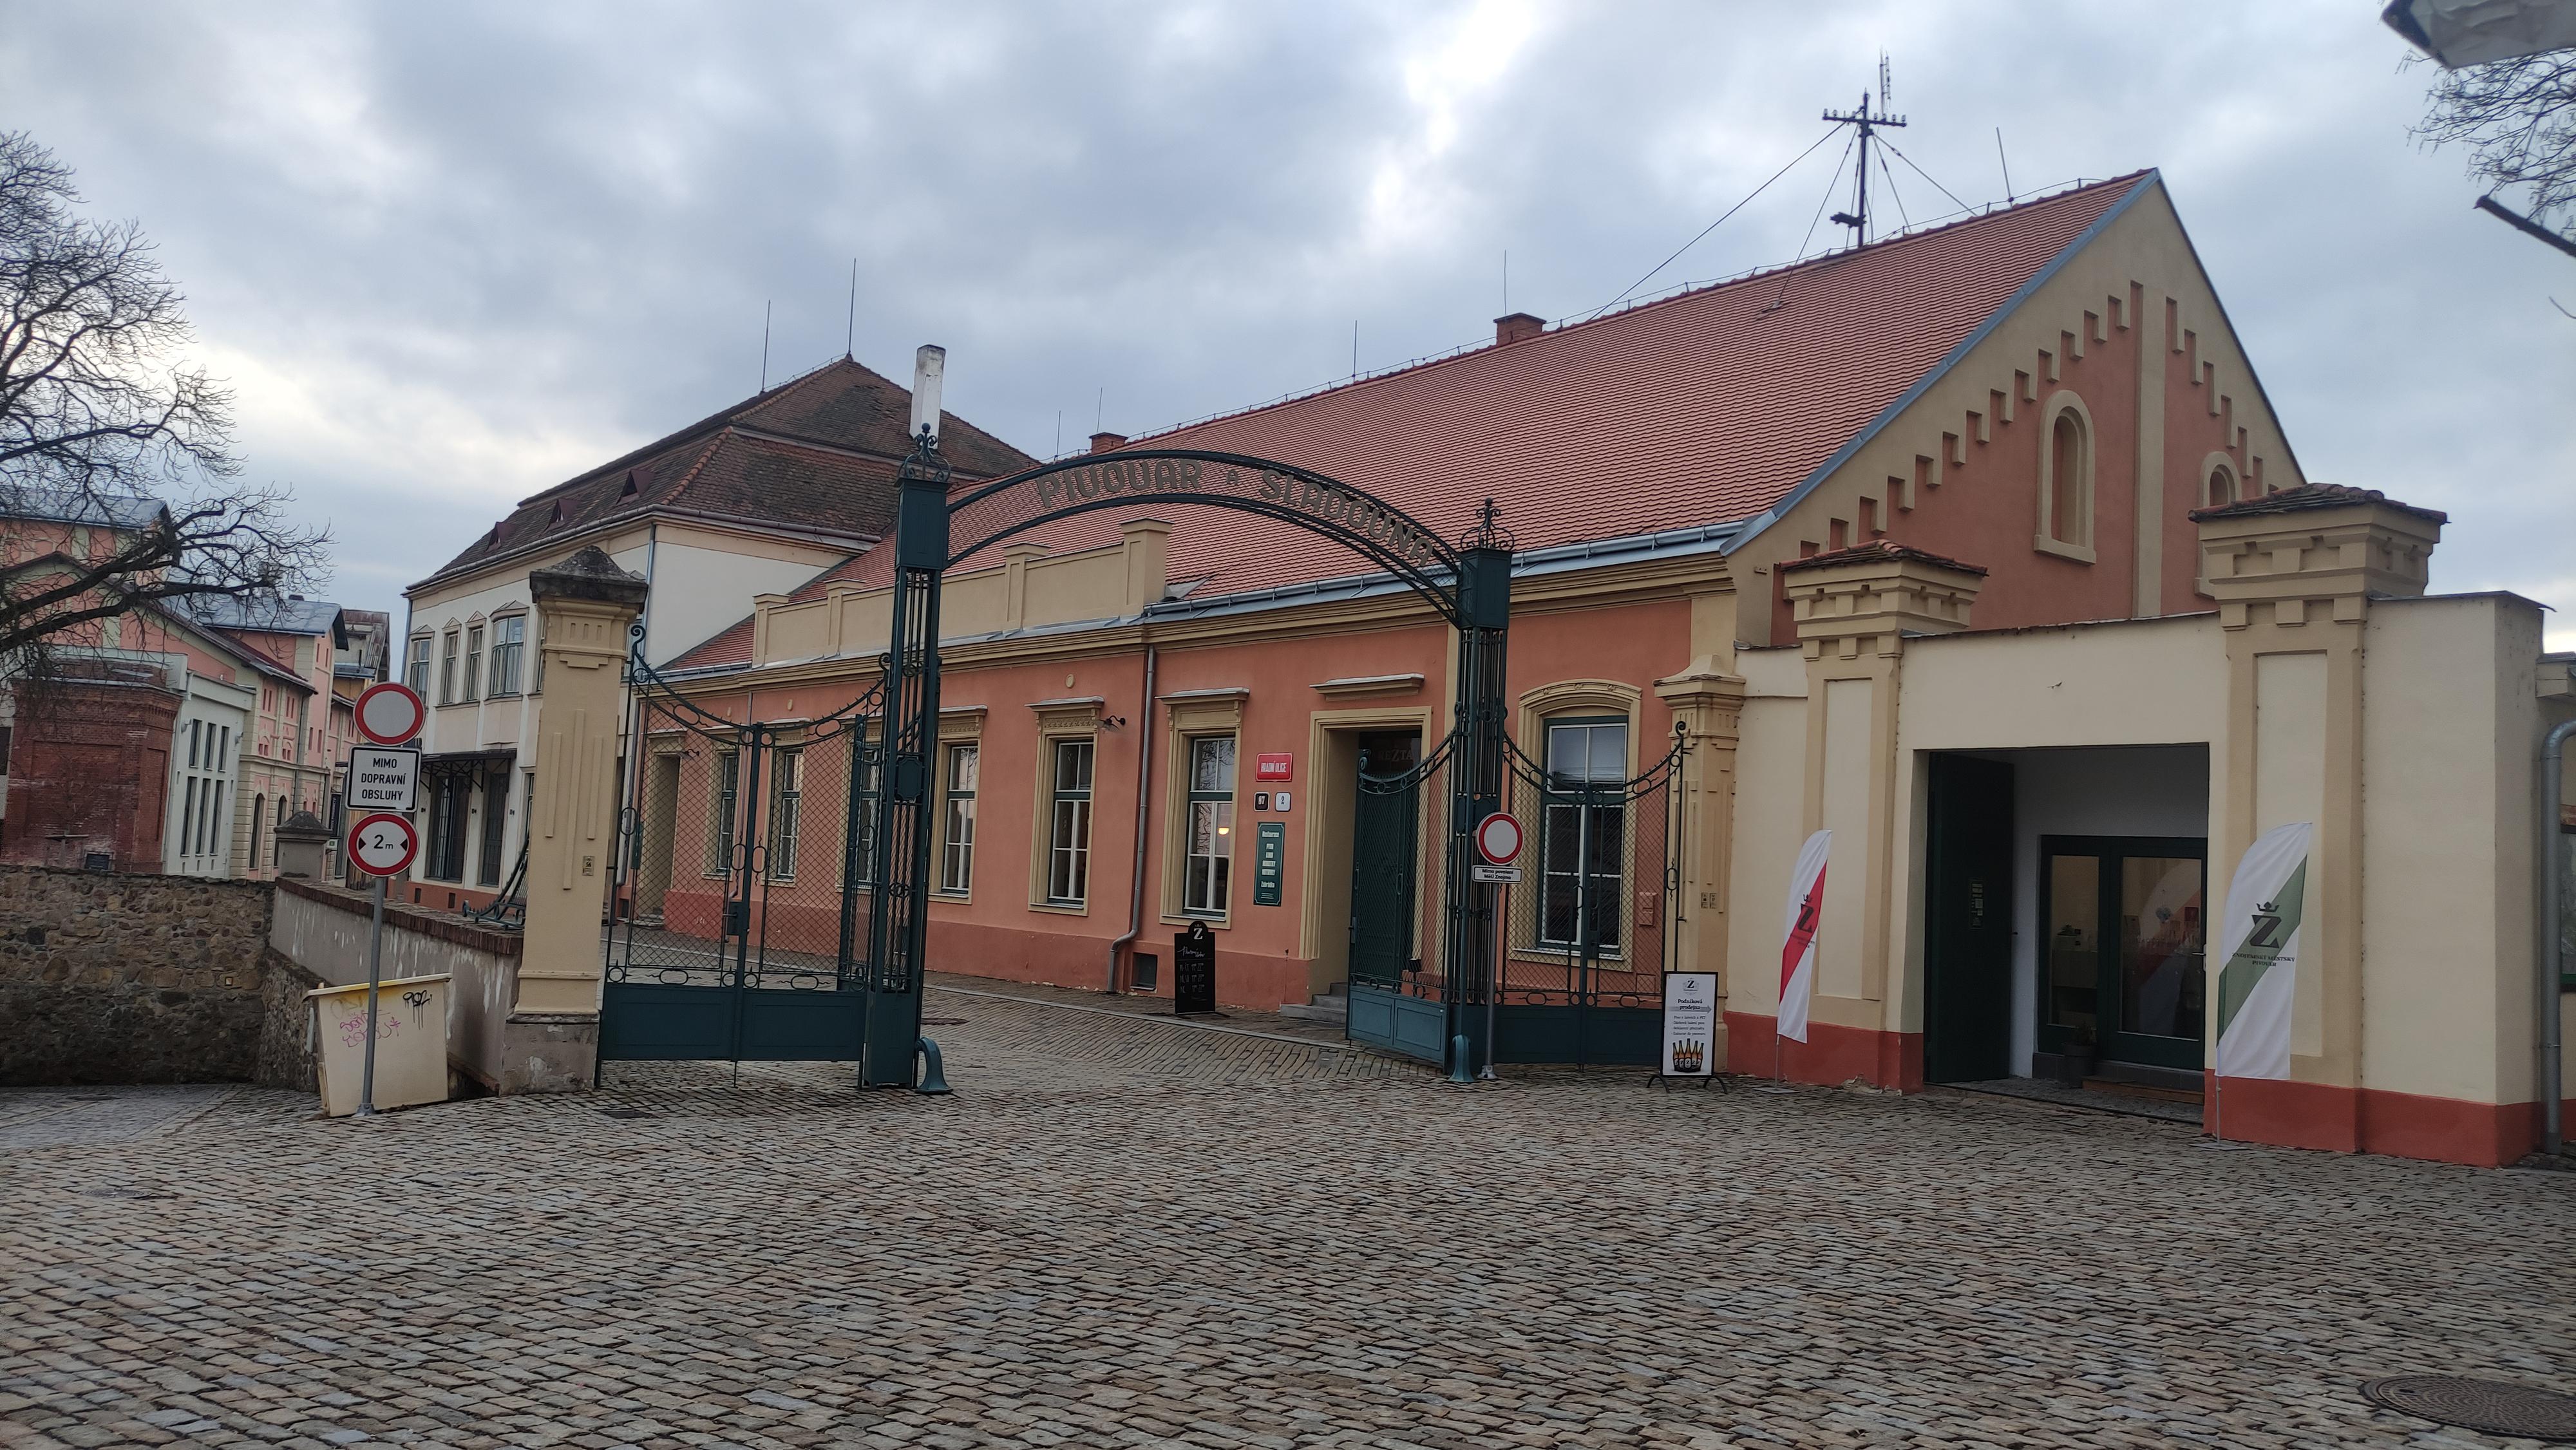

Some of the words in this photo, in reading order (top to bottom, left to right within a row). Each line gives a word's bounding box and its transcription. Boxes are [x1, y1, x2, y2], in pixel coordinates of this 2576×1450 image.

[373, 757, 397, 769] MIMO
[361, 773, 406, 785] DOPRAVNÍ
[362, 789, 403, 801] OBSLUHY
[1281, 796, 1285, 804] 2
[1193, 928, 1203, 939] Z
[1687, 980, 1695, 988] Z
